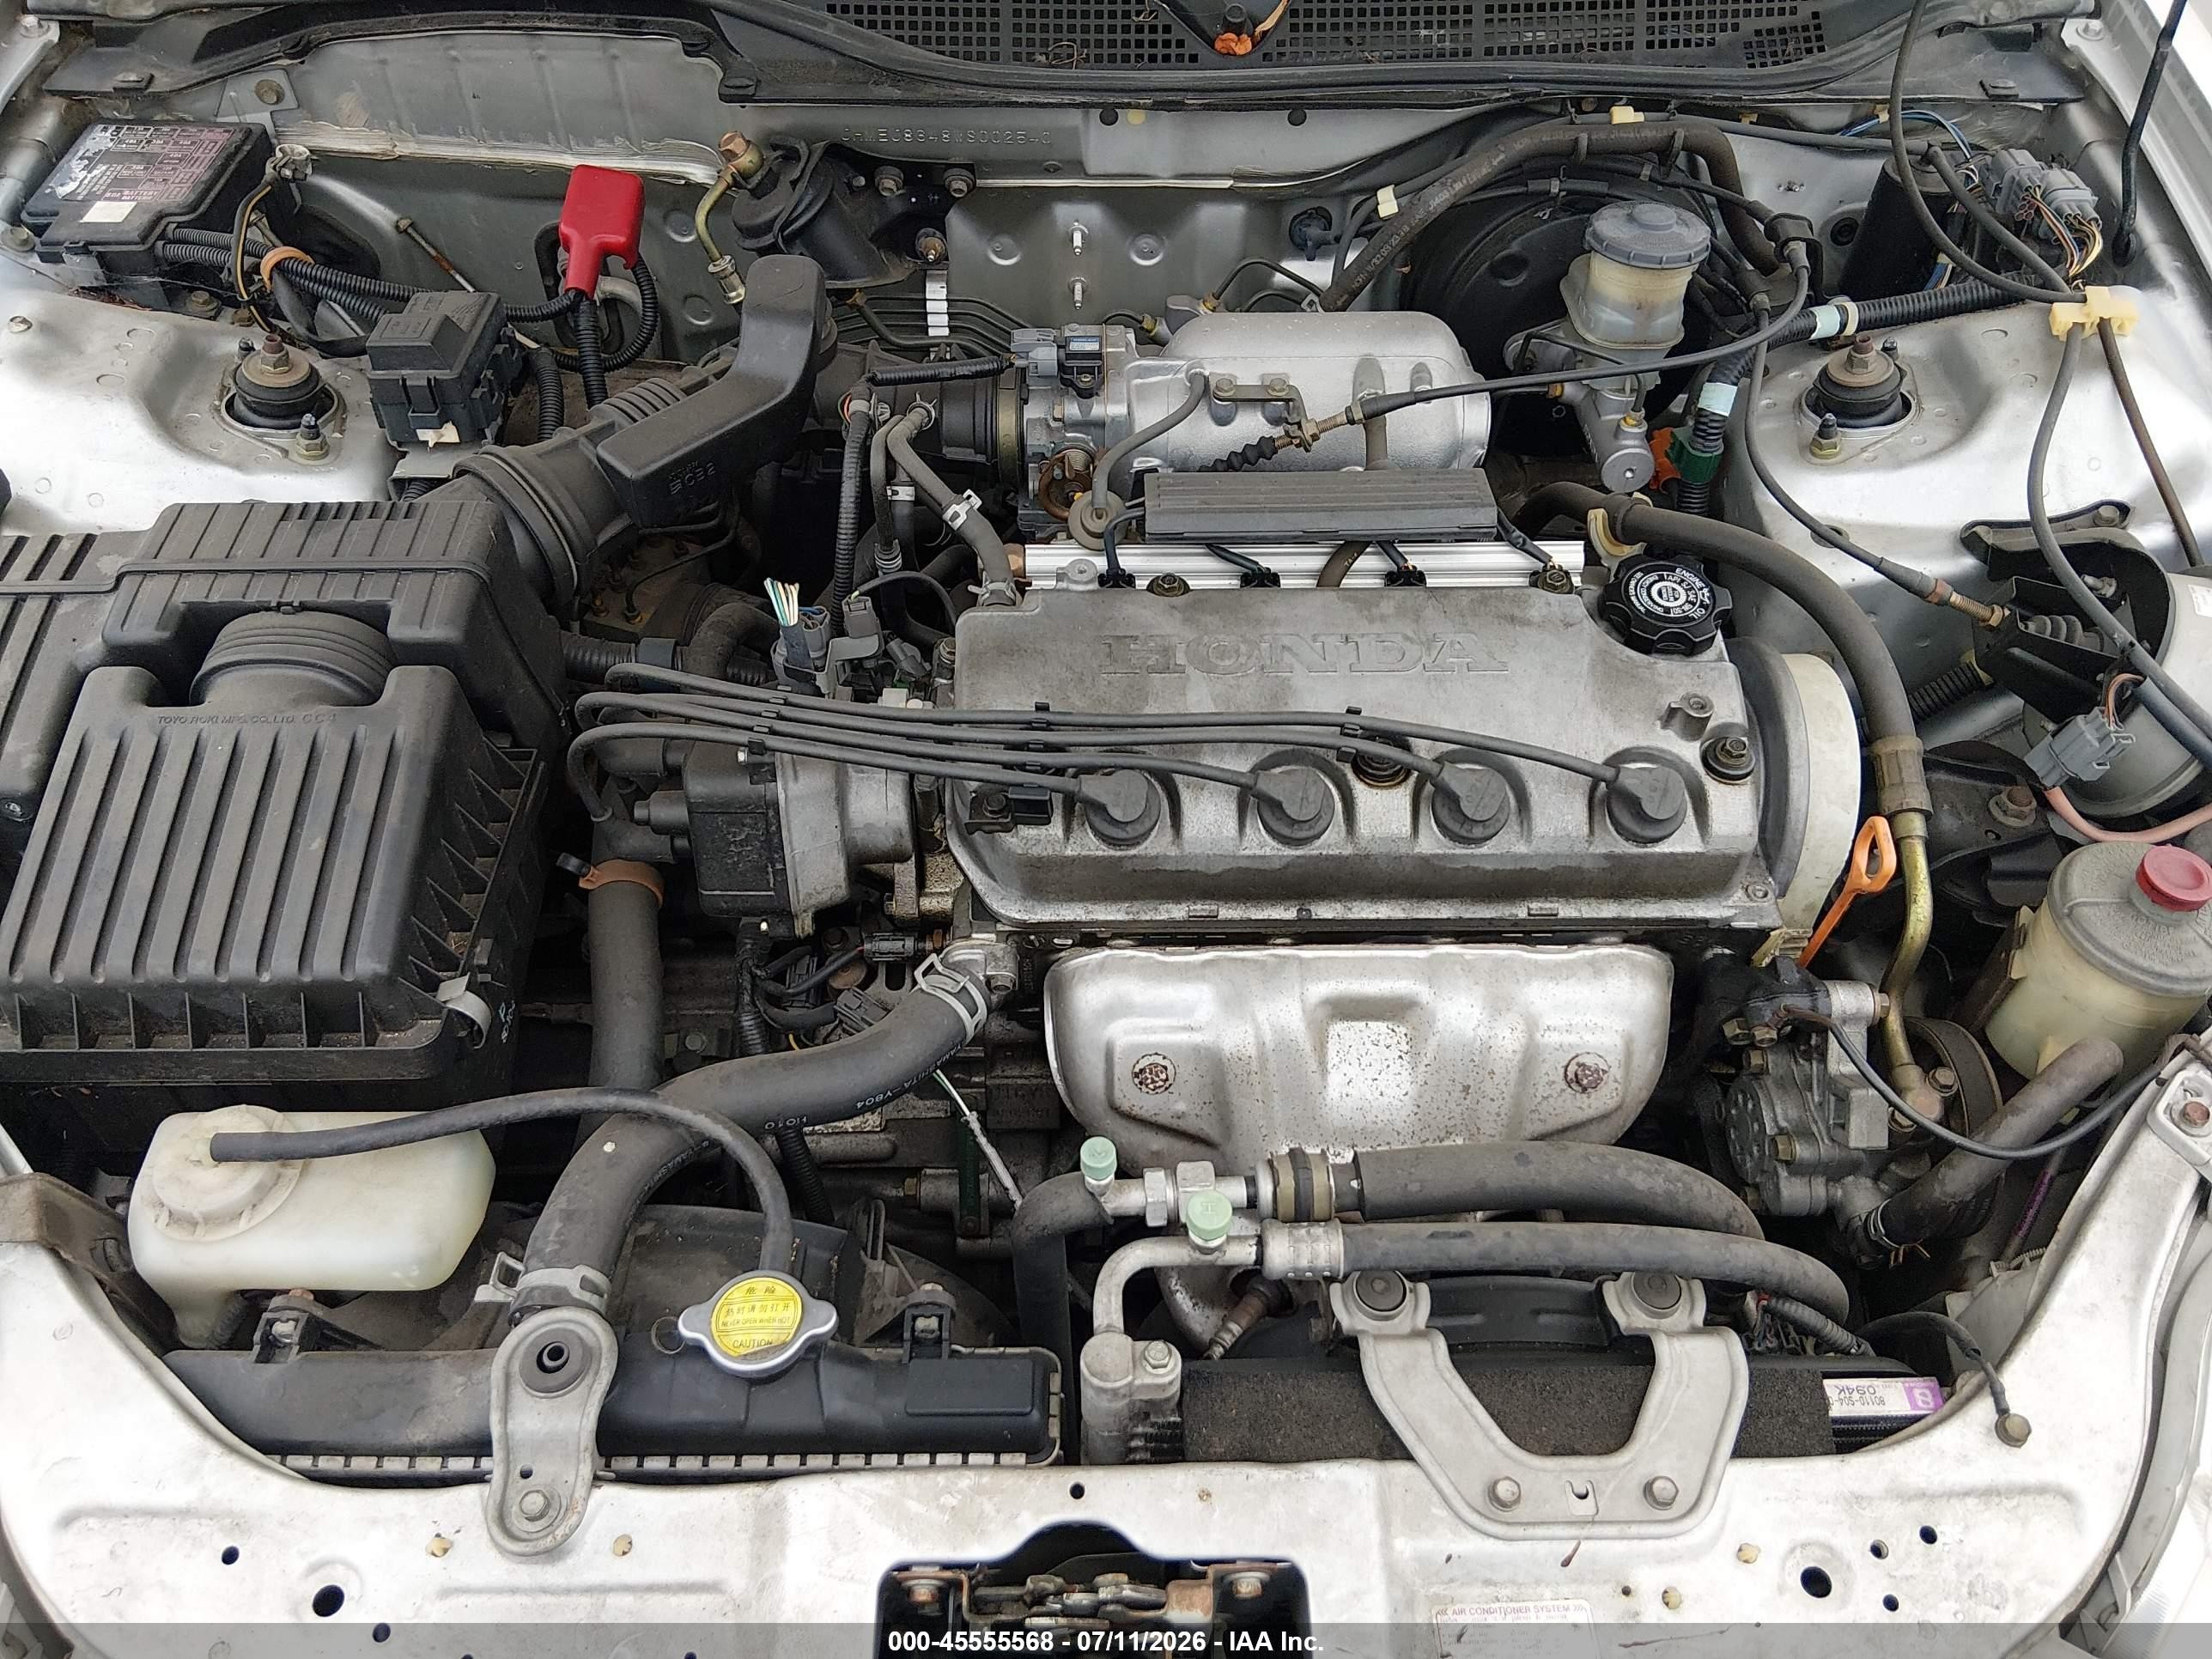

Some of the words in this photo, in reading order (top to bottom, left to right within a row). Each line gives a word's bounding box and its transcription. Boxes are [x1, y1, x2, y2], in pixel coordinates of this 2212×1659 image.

[1667, 574, 1680, 583] API
[1675, 568, 1705, 589] ENGINE
[1688, 607, 1706, 620] OIL
[1100, 632, 1510, 675] HONDA
[158, 715, 186, 725] TOYO
[732, 1339, 774, 1348] CAUTION
[1834, 1384, 1876, 1395] 094K
[1451, 1607, 1468, 1616] AIR
[1468, 1606, 1531, 1616] CONDITIONER
[1534, 1604, 1570, 1613] SYSTEM
